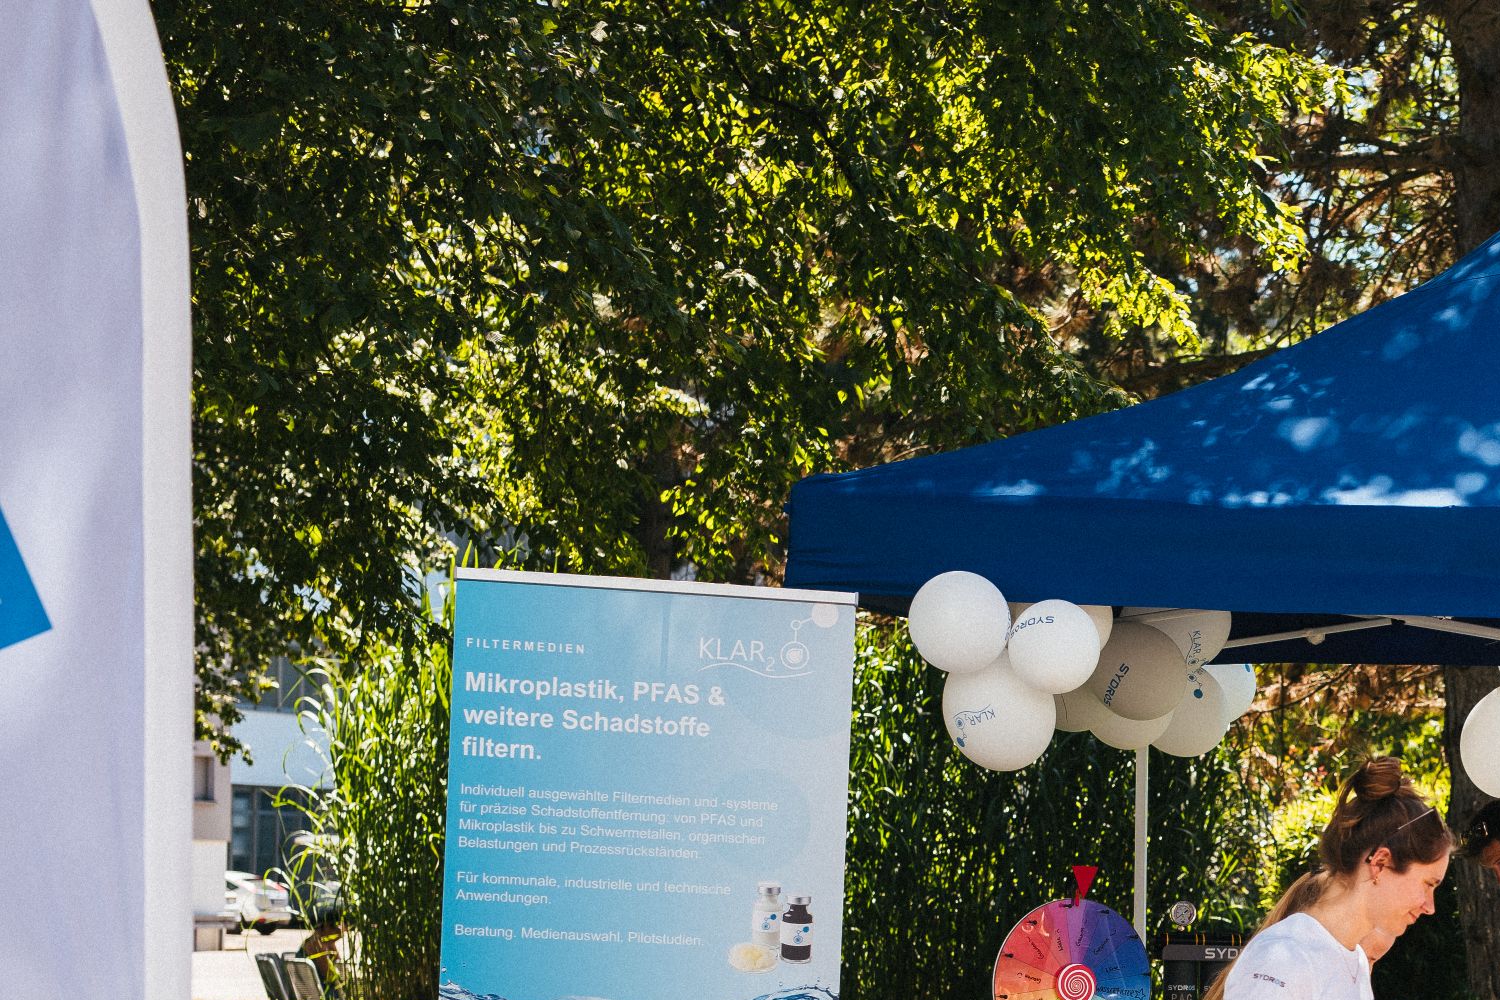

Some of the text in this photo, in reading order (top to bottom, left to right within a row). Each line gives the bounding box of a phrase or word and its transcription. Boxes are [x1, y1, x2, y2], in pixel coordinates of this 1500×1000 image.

[465, 636, 585, 655] FILTERMEDIEN
[464, 670, 725, 706] Mikroplastik, PFAS &
[462, 705, 710, 737] weitere Schadstoffe
[461, 735, 542, 760] filtern.
[460, 782, 525, 798] Individuell
[527, 788, 609, 803] ausgewählte
[612, 790, 691, 806] Filtermedien
[694, 796, 718, 808] und
[456, 870, 732, 897] Für kommunale, industrielle und technische
[454, 923, 517, 941] Beratung.
[520, 926, 623, 943] Medienauswahl.
